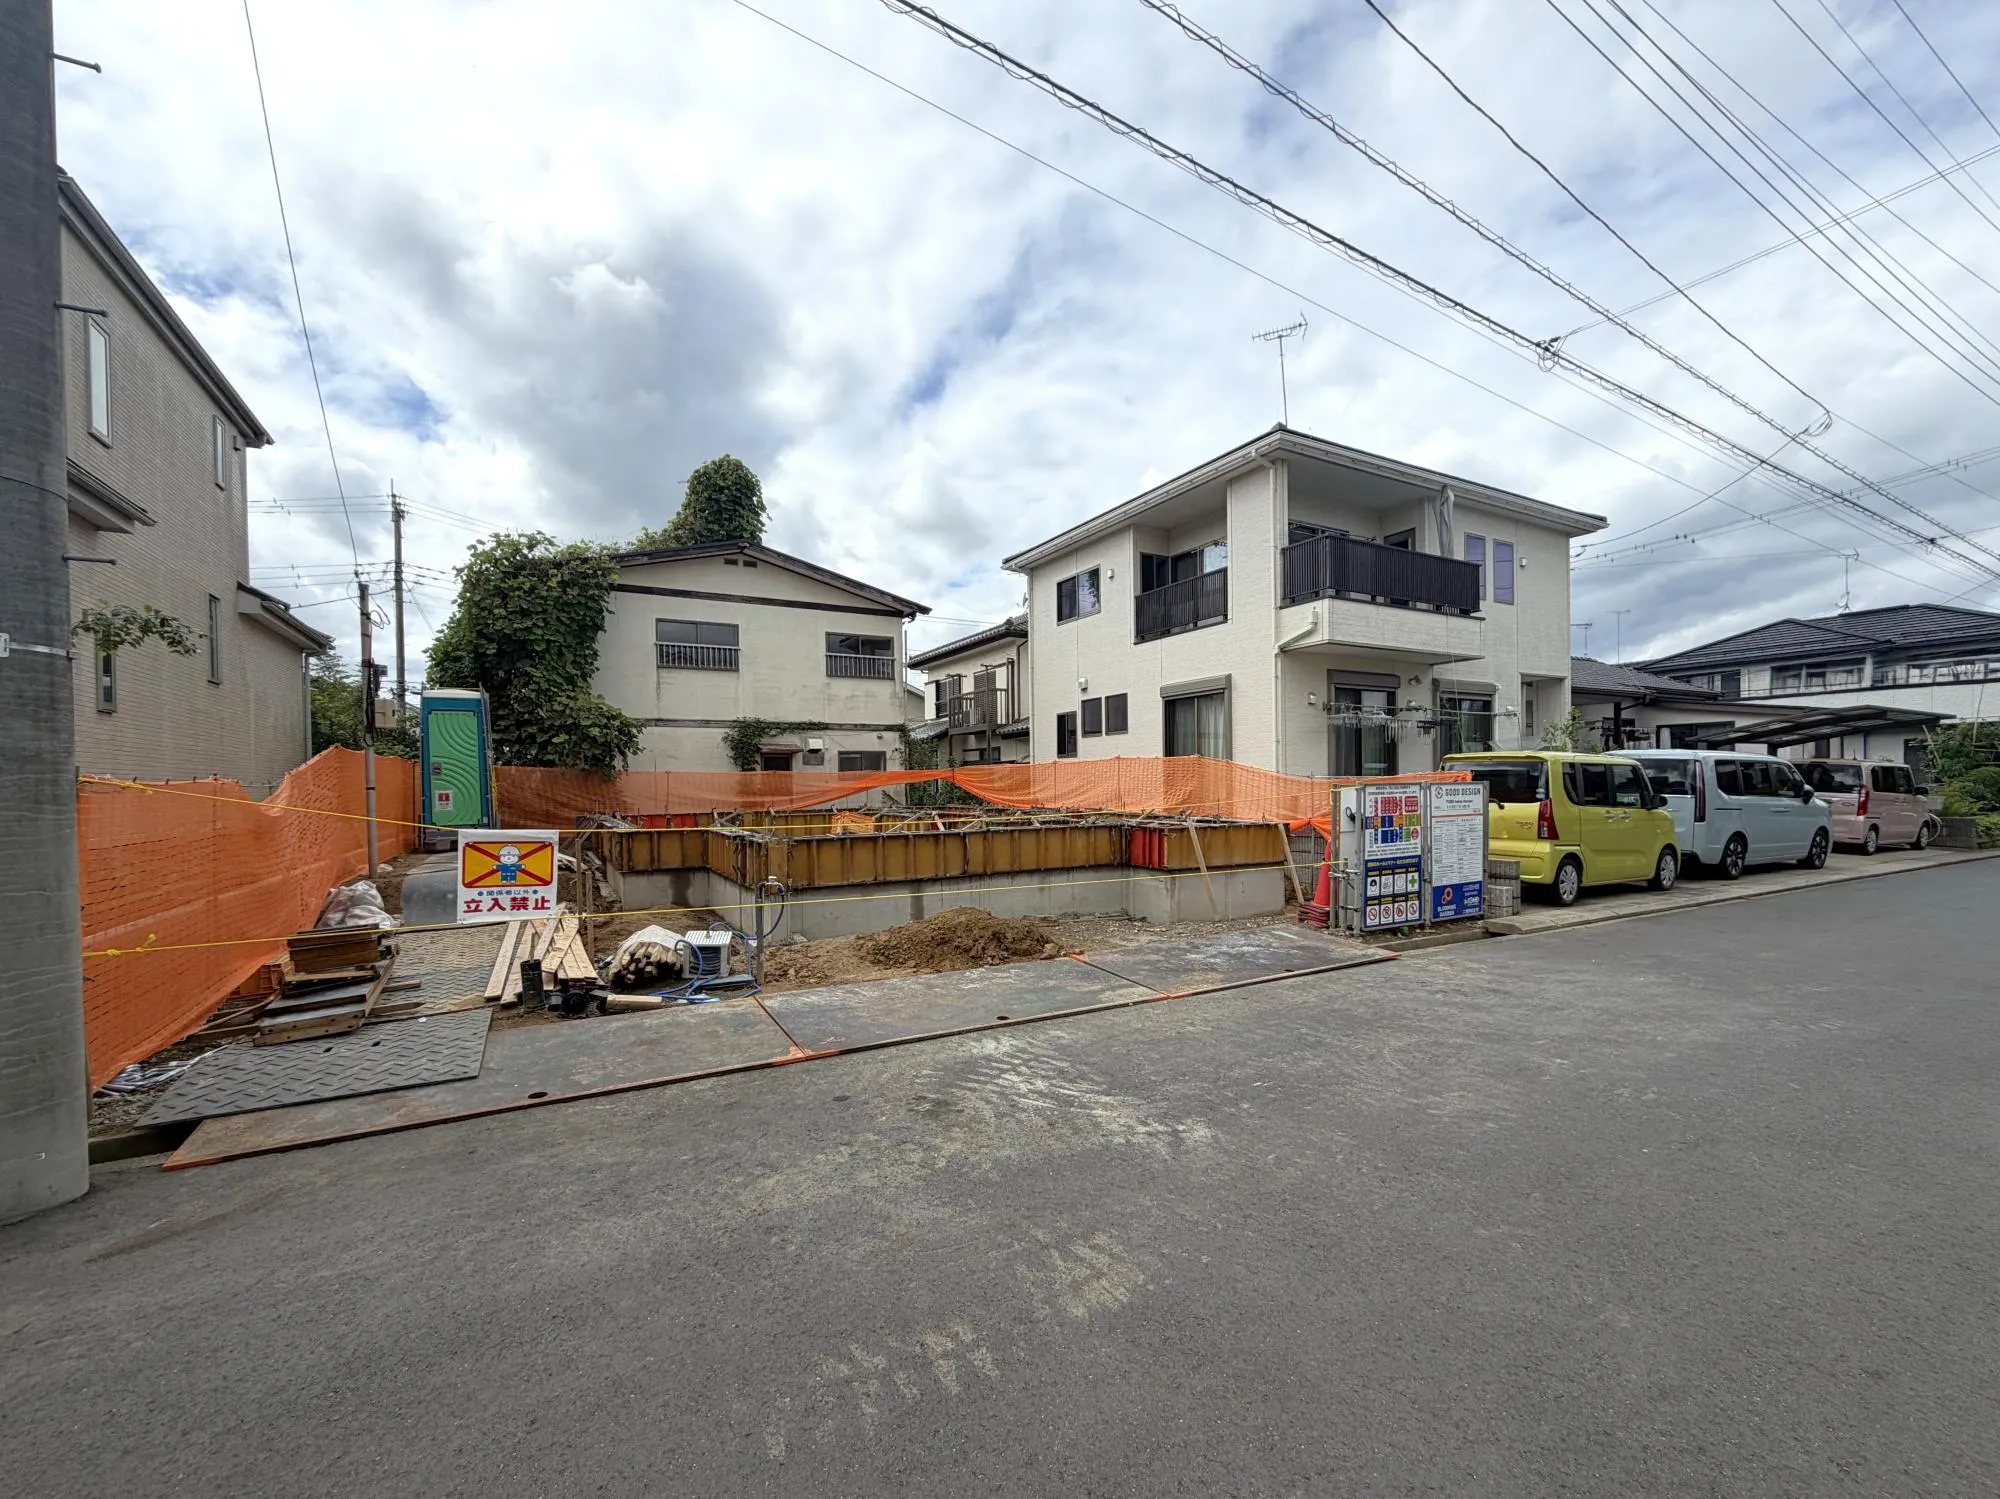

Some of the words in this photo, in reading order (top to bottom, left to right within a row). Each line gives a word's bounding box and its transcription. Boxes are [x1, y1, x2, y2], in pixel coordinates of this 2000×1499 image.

[1445, 788, 1460, 796] GOOD
[1461, 787, 1481, 796] DESIGN
[486, 889, 530, 897] 関係者以外
[463, 896, 552, 913] 立入禁止
